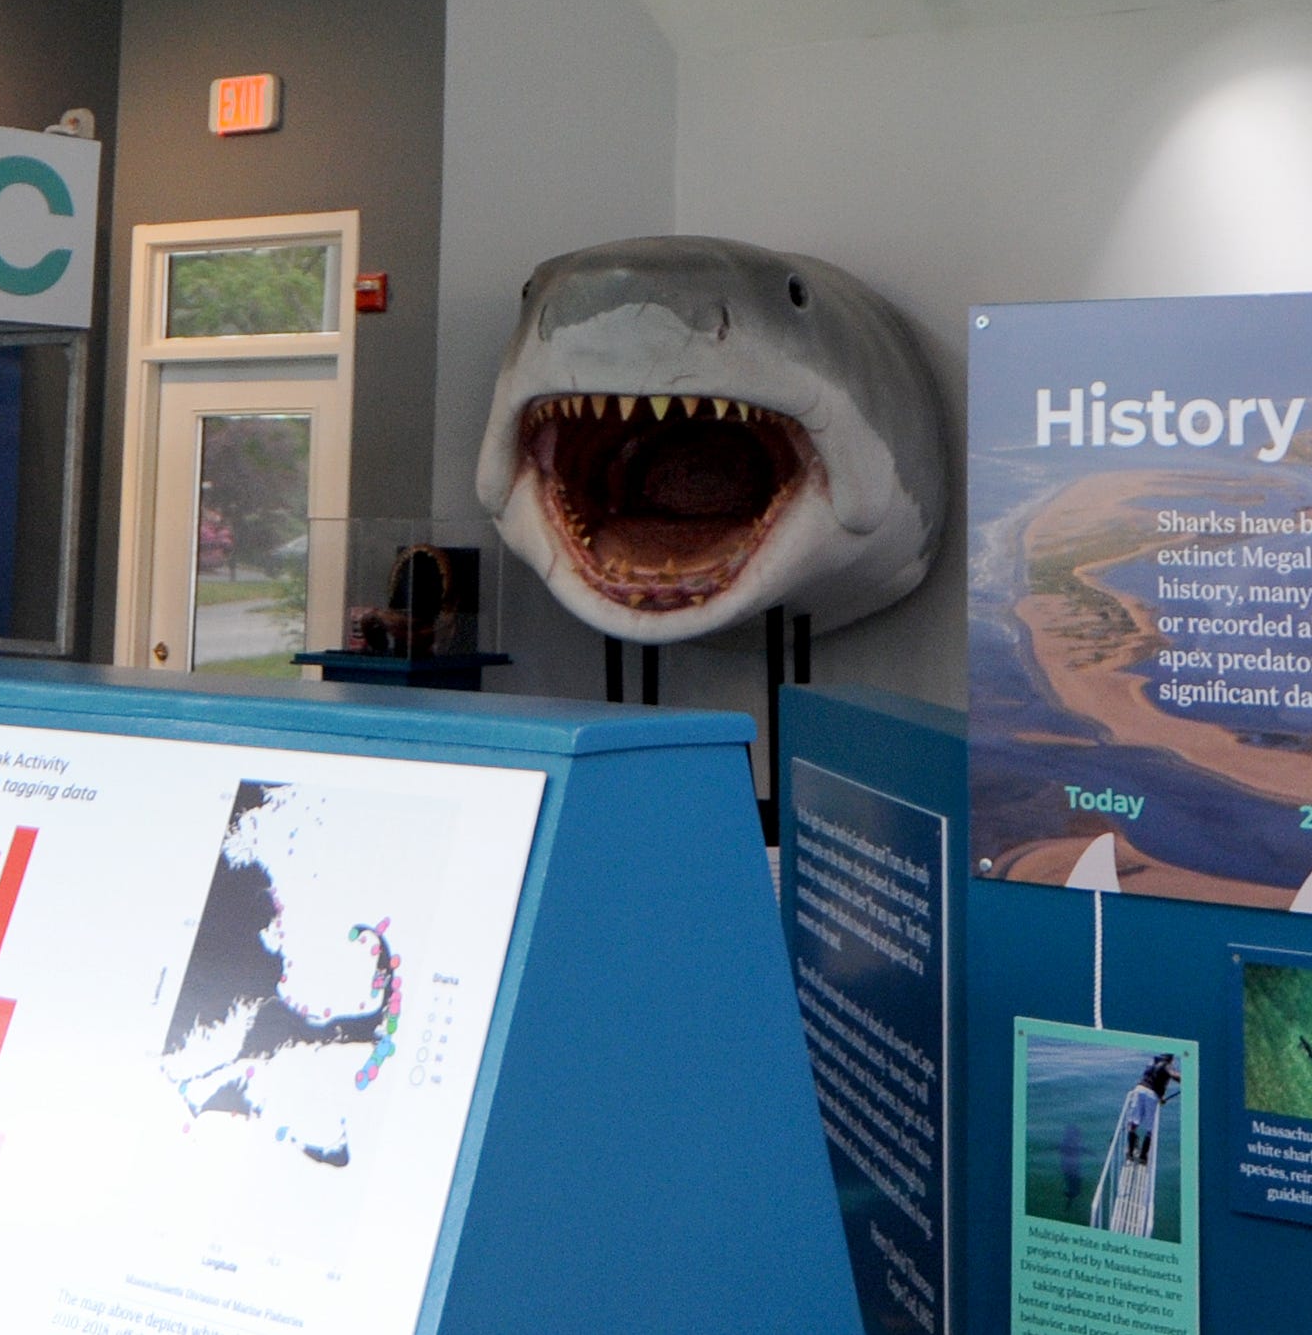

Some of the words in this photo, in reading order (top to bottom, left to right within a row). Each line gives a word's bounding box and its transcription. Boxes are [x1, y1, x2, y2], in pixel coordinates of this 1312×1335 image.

[217, 76, 266, 135] EXIT
[1036, 381, 1305, 462] History
[1157, 510, 1235, 534] Sharks
[1241, 511, 1295, 535] have
[1157, 545, 1237, 568] extinct
[1158, 577, 1245, 608] history,
[1249, 586, 1312, 611] many
[1158, 616, 1185, 633] or
[1187, 614, 1292, 638] recorded
[1158, 650, 1212, 673] apex
[1159, 679, 1279, 708] significant
[14, 753, 69, 774] Activity
[2, 777, 60, 800] tagging
[62, 783, 97, 801] data
[1064, 785, 1145, 820] Today
[1247, 1141, 1282, 1158] white
[1240, 1162, 1289, 1182] species,
